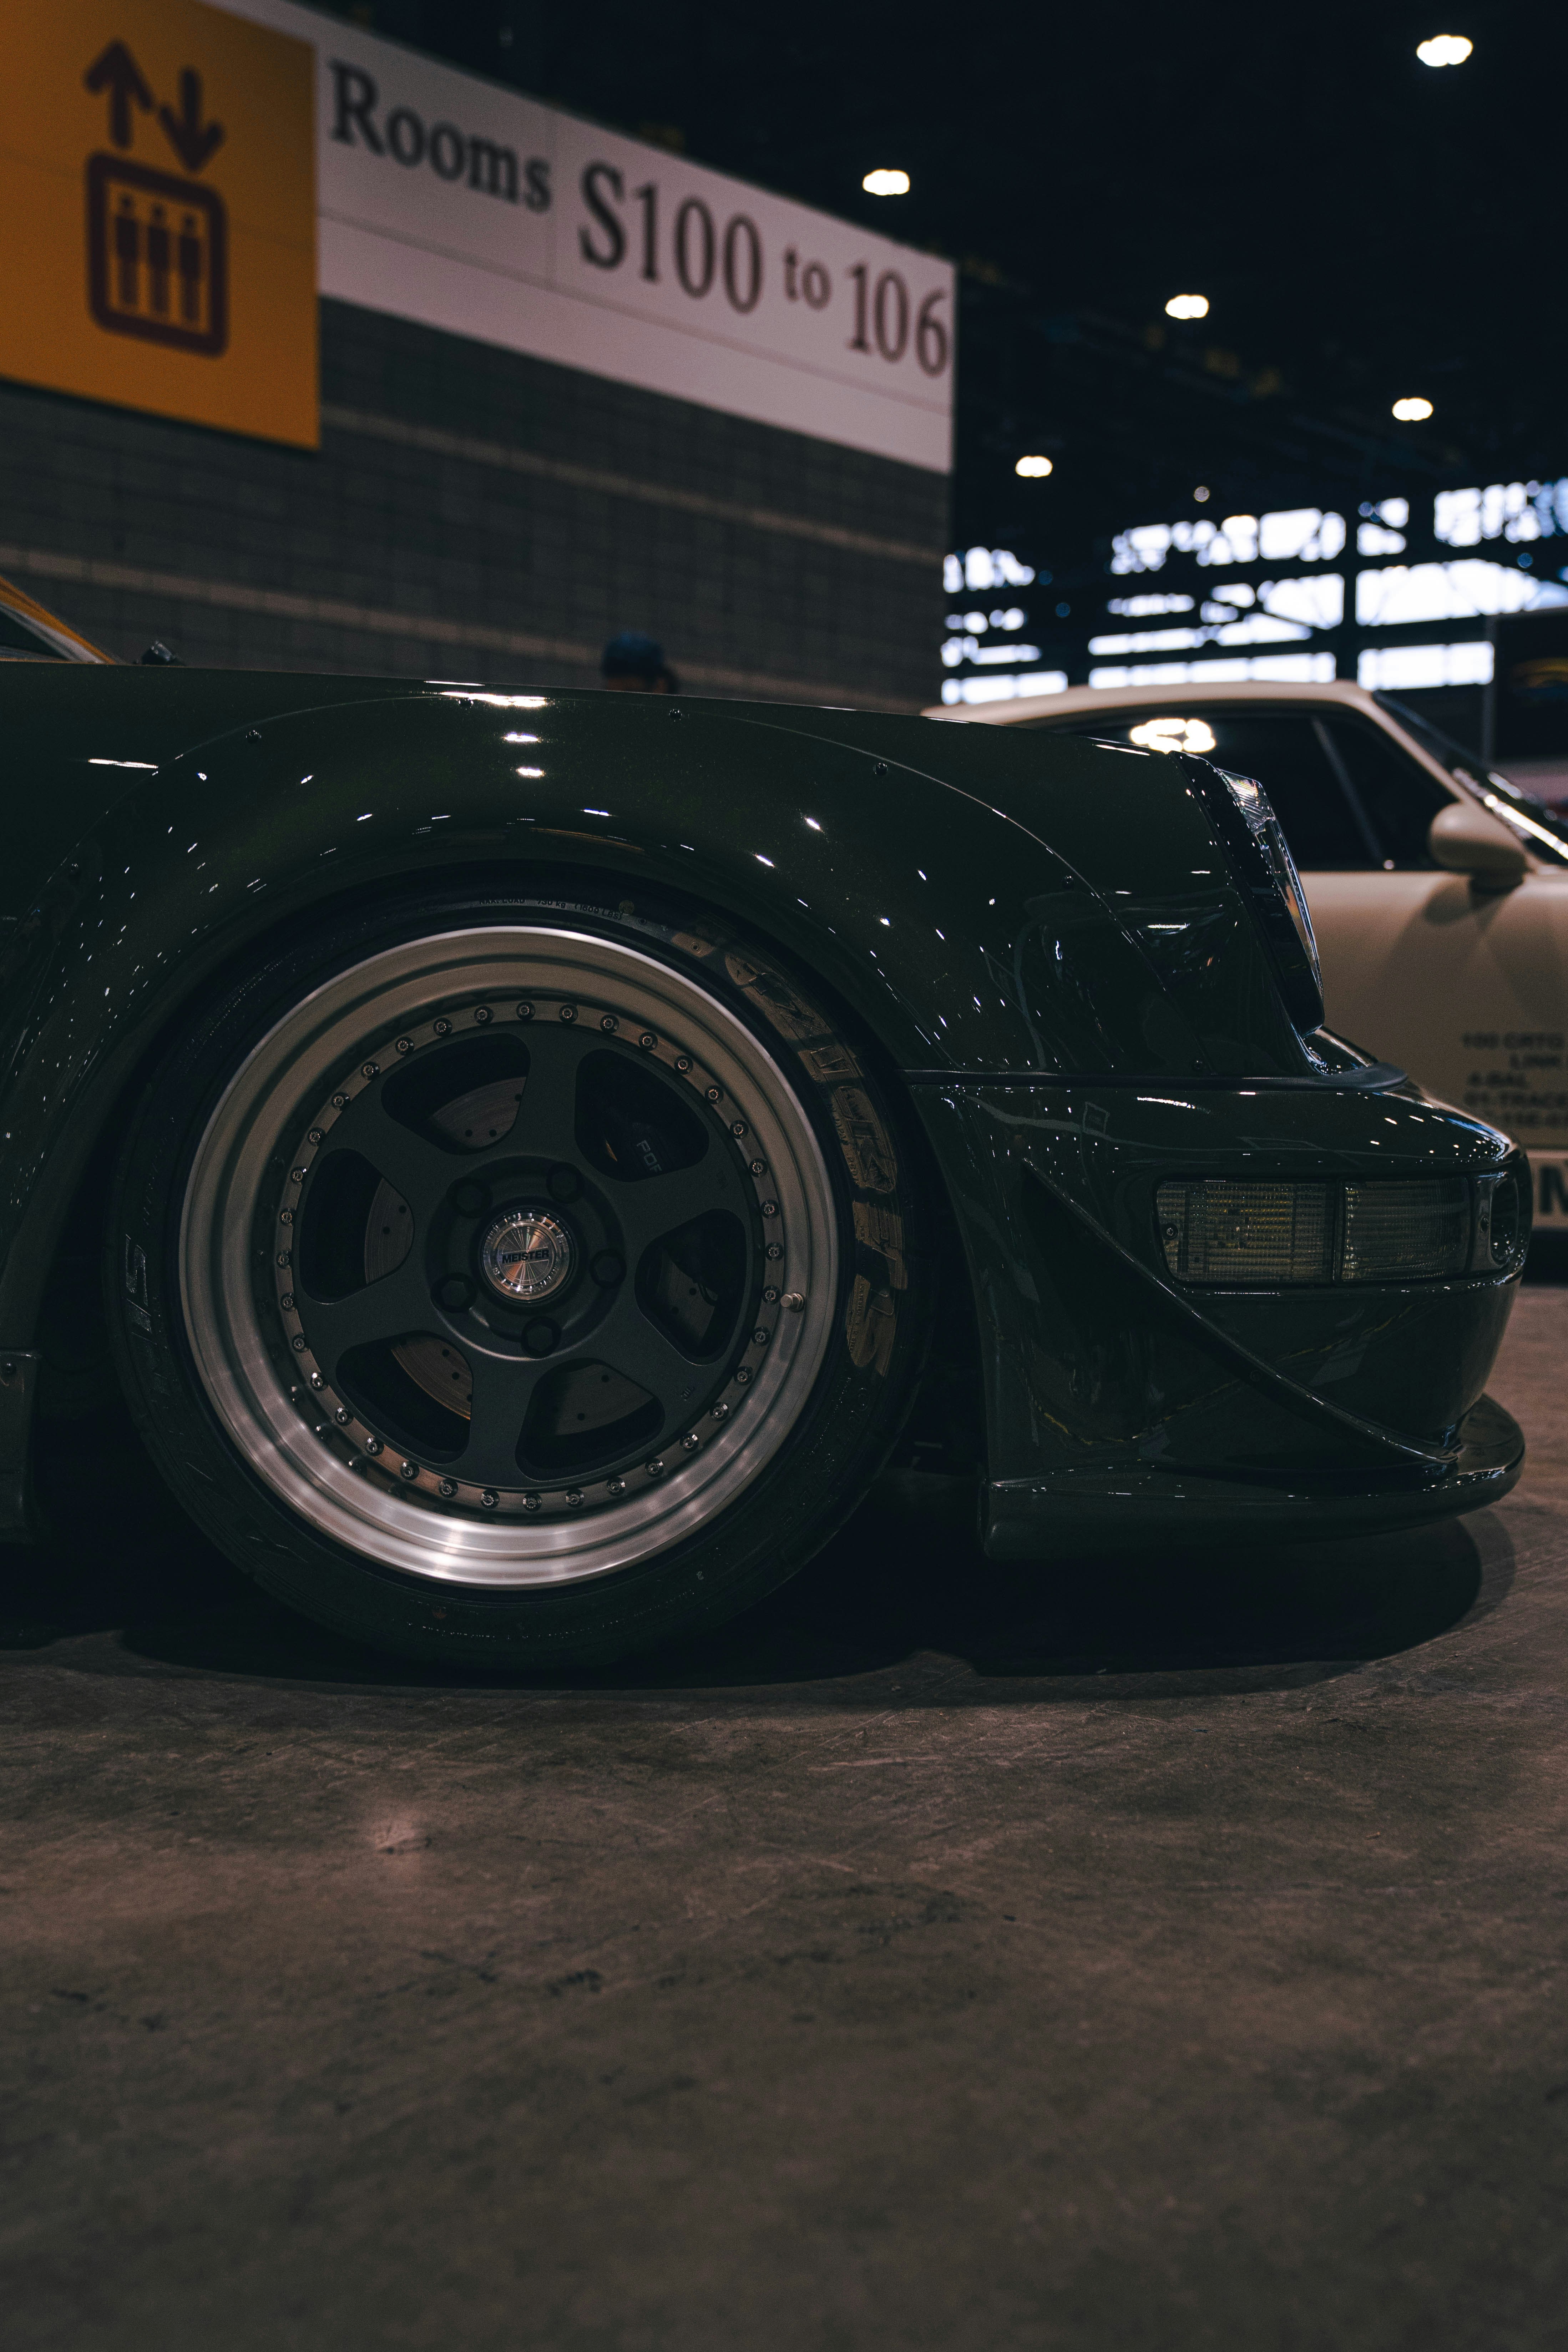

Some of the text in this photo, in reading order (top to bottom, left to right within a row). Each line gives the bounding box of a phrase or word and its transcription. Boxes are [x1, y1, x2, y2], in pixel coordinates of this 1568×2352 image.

[330, 59, 947, 377] Rooms S100 to 106
[555, 900, 566, 909] kg
[502, 1250, 549, 1264] MEISTER
